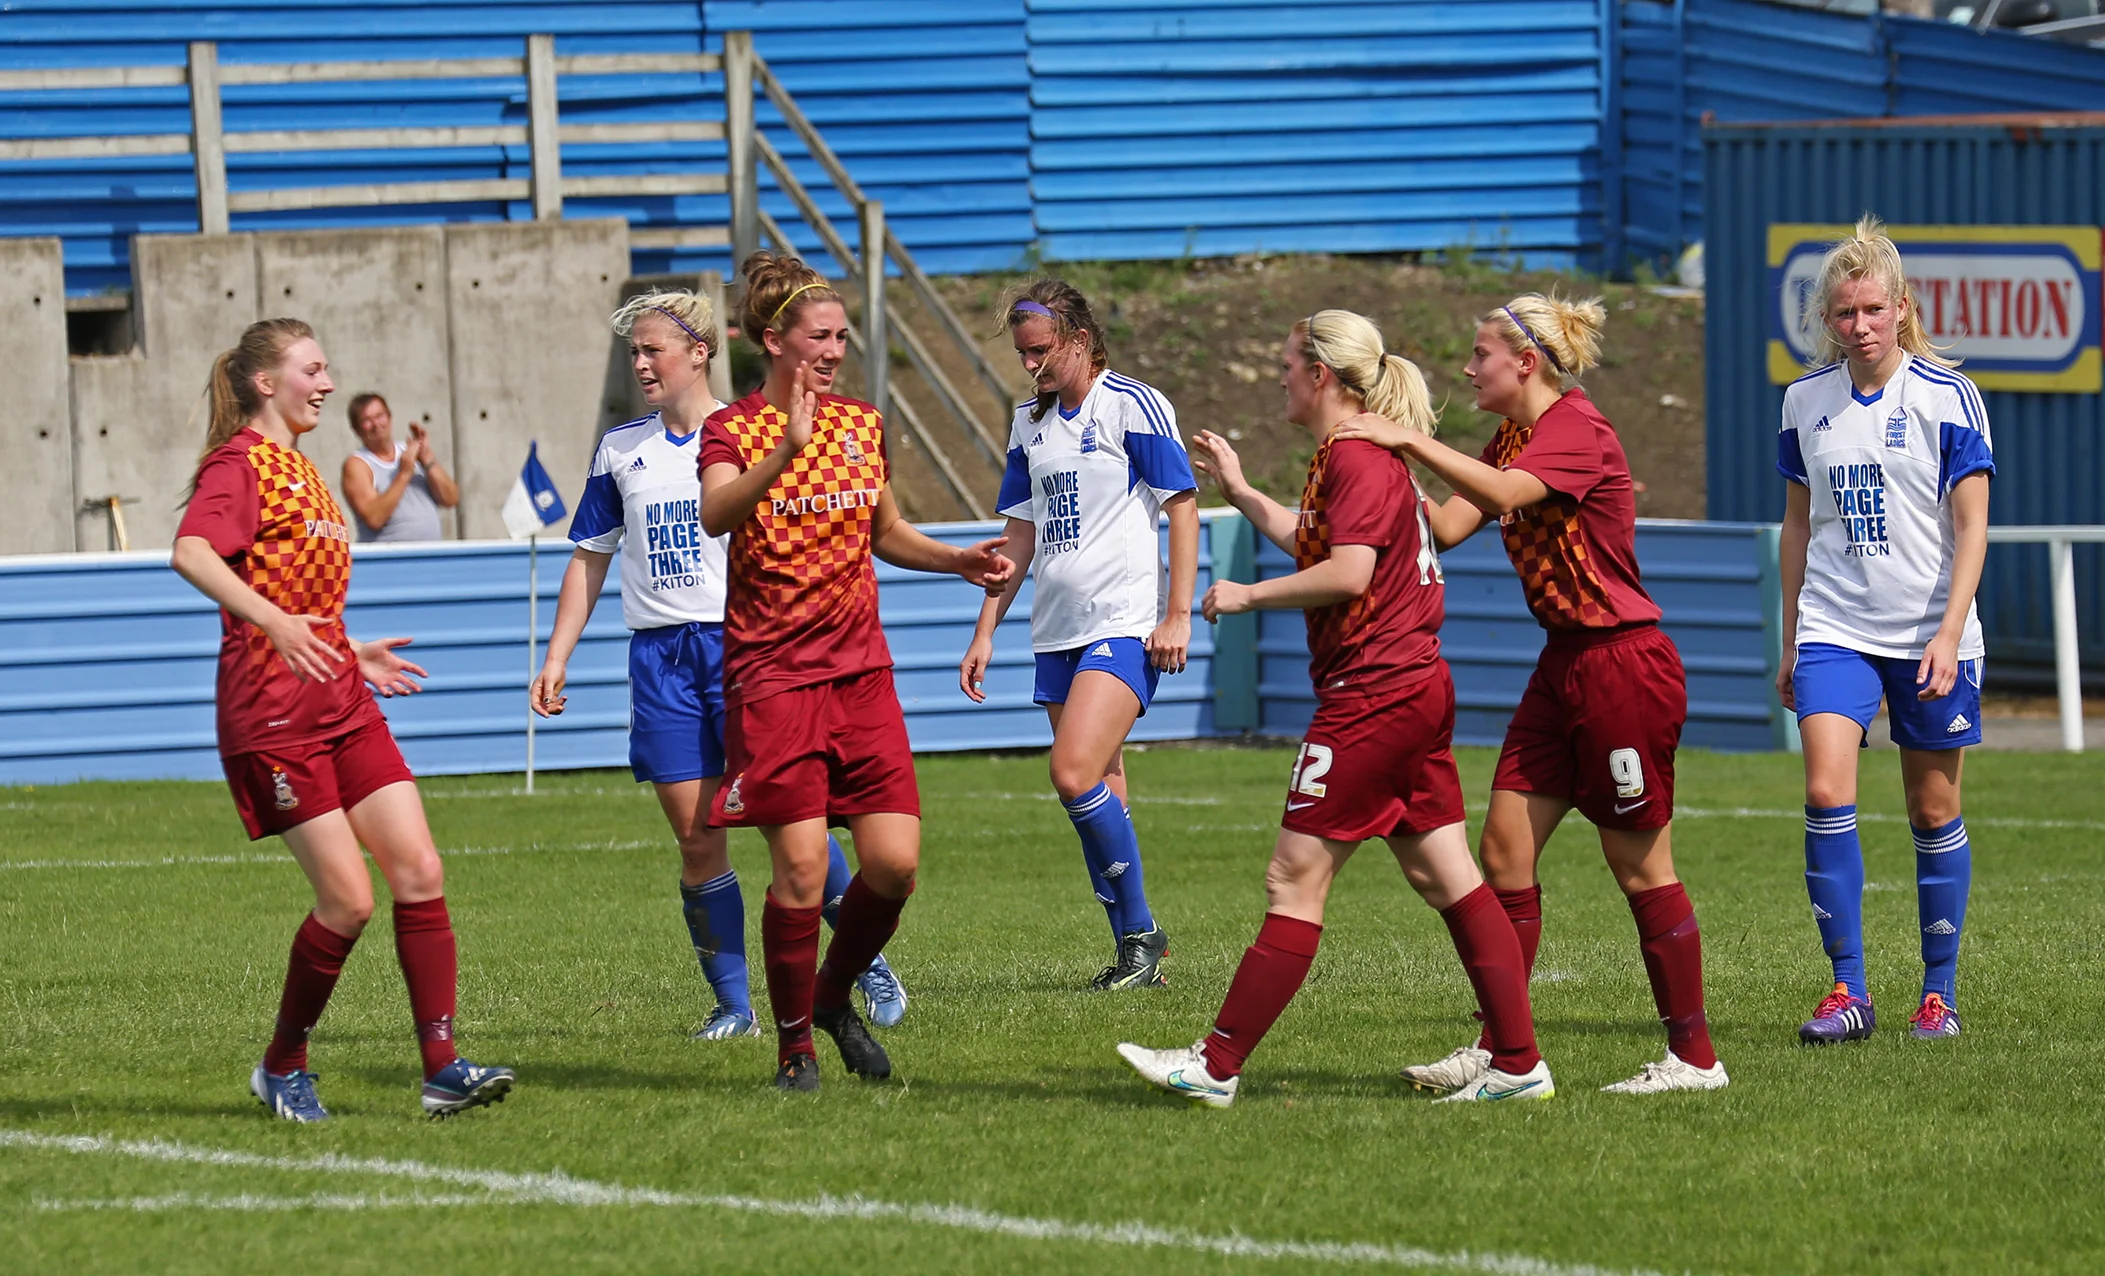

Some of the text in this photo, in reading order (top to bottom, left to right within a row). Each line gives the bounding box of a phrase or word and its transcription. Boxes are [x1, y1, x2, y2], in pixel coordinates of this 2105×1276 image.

[1040, 474, 1055, 498] NO
[1829, 463, 1885, 489] NO MORE
[646, 499, 699, 526] NO MORE
[771, 488, 879, 517] PATCHETT
[1832, 488, 1886, 516] PAGE
[647, 522, 701, 552] PAGE
[1841, 516, 1889, 543] HREE
[648, 549, 703, 578] THREE
[1844, 543, 1890, 558] #ITON
[652, 574, 705, 592] #KITON
[1289, 742, 1333, 798] 12
[1609, 747, 1644, 798] 9
